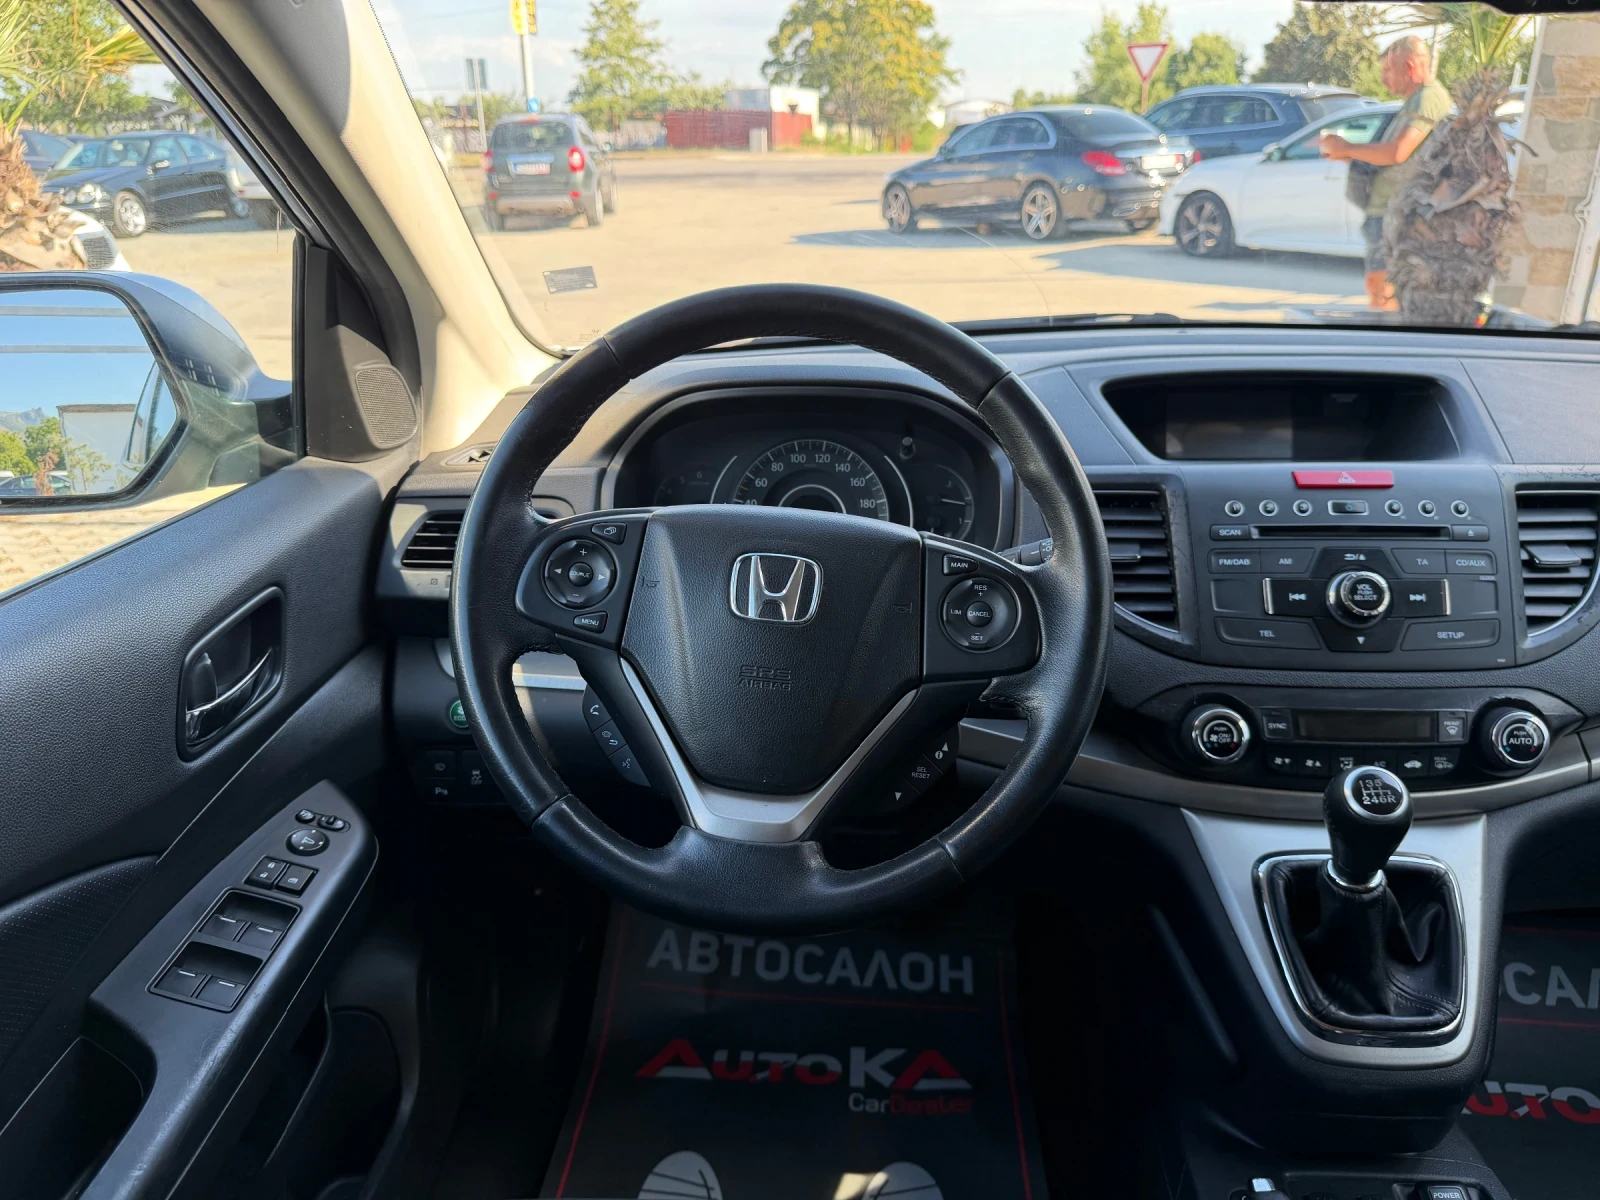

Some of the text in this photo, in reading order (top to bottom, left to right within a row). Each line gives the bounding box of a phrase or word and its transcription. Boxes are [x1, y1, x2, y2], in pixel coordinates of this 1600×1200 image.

[789, 453, 807, 464] 100
[814, 453, 831, 464] 120
[771, 462, 784, 472] 80
[834, 463, 851, 473] 140
[754, 477, 768, 488] 60
[850, 477, 866, 487] 160
[859, 499, 876, 509] 180
[1265, 502, 1274, 511] 2
[1299, 502, 1308, 511] 3
[1218, 528, 1242, 536] SCAN
[950, 561, 969, 569] MAIN
[1218, 558, 1251, 566] FM/DAB
[1278, 557, 1294, 565] AM
[1416, 558, 1429, 566] TA
[1455, 559, 1486, 567] CD/AUX
[950, 608, 962, 616] LIM
[968, 610, 991, 618] CANCEL
[581, 618, 600, 627] MENU
[1258, 629, 1276, 638] TEL
[1436, 631, 1465, 639] SETUP
[1267, 722, 1287, 730] SYNC
[1508, 737, 1533, 745] AUTO
[911, 771, 931, 779] RESET
[646, 927, 975, 996] АВТОСАЛОН
